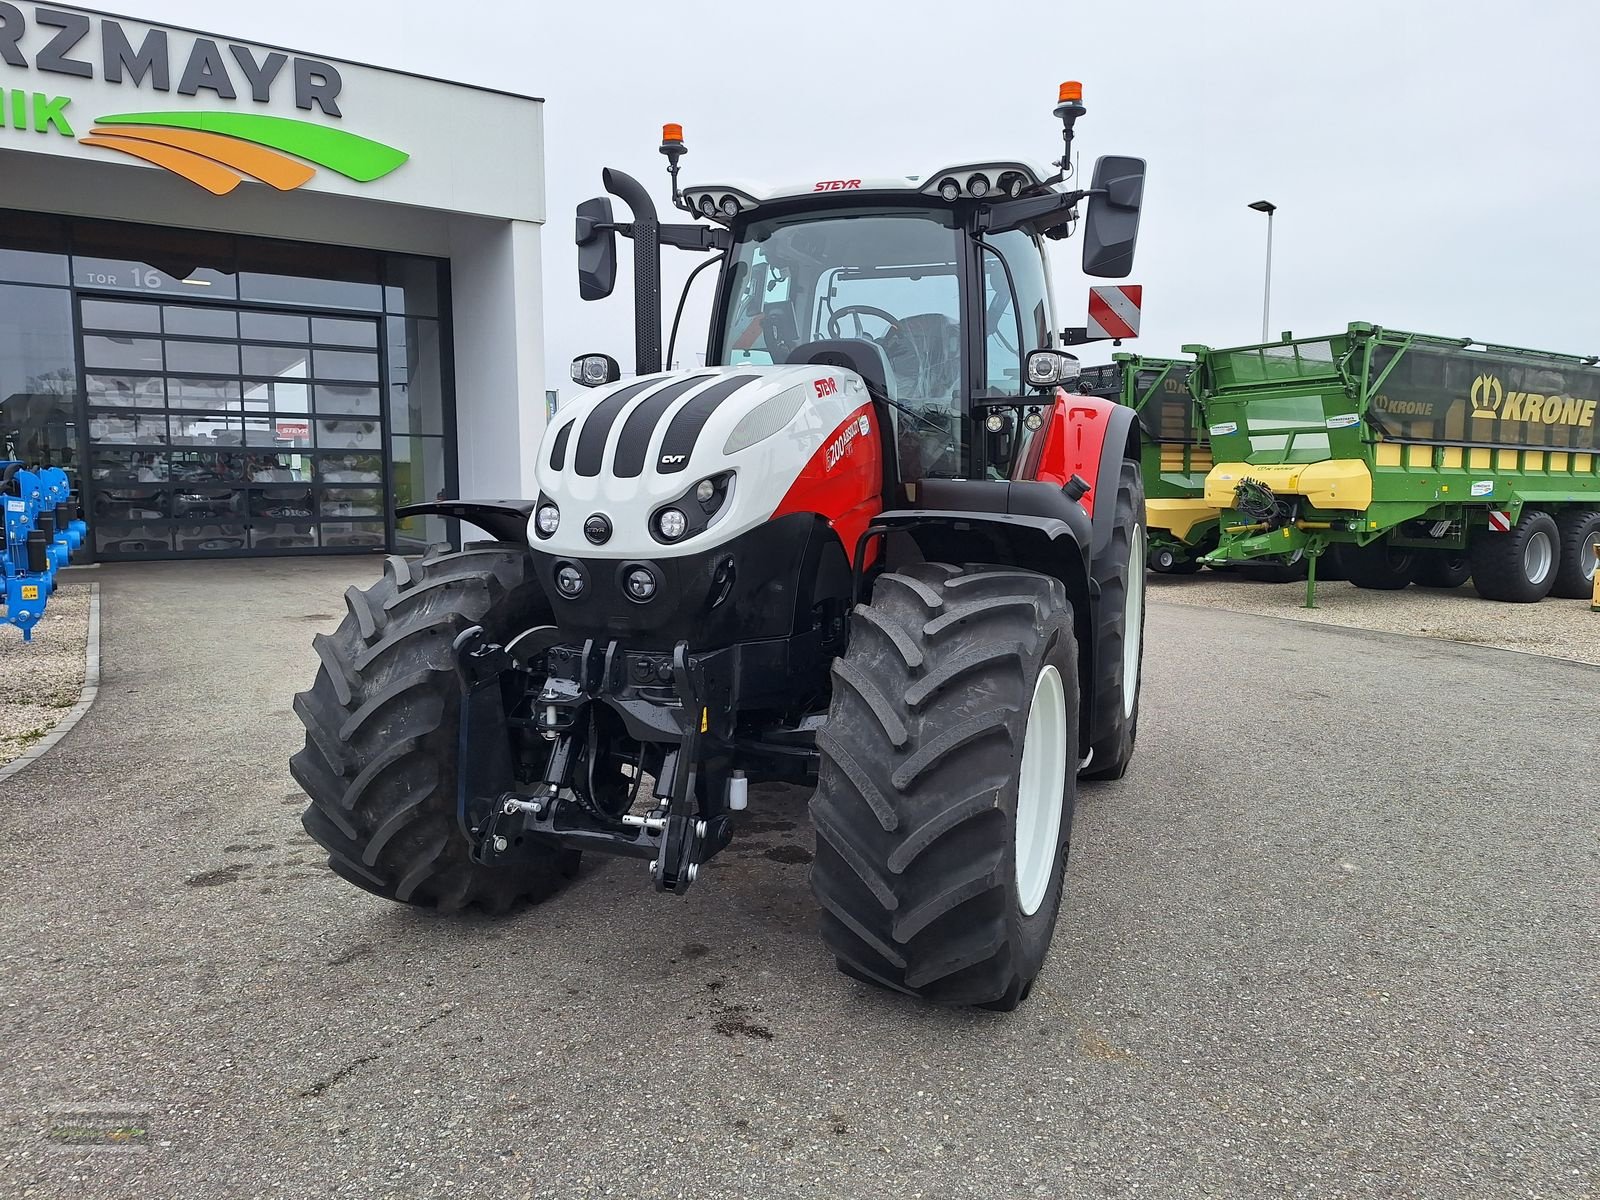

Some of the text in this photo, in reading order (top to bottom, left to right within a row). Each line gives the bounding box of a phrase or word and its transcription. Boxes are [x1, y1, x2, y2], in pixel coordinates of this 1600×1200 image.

[0, 86, 75, 137] IK
[813, 179, 862, 192] STEYR
[87, 267, 162, 289] TOR 16
[814, 377, 838, 398] STEYR
[1387, 400, 1434, 416] KRONE
[1500, 391, 1597, 427] KRONE
[661, 454, 686, 464] CVT
